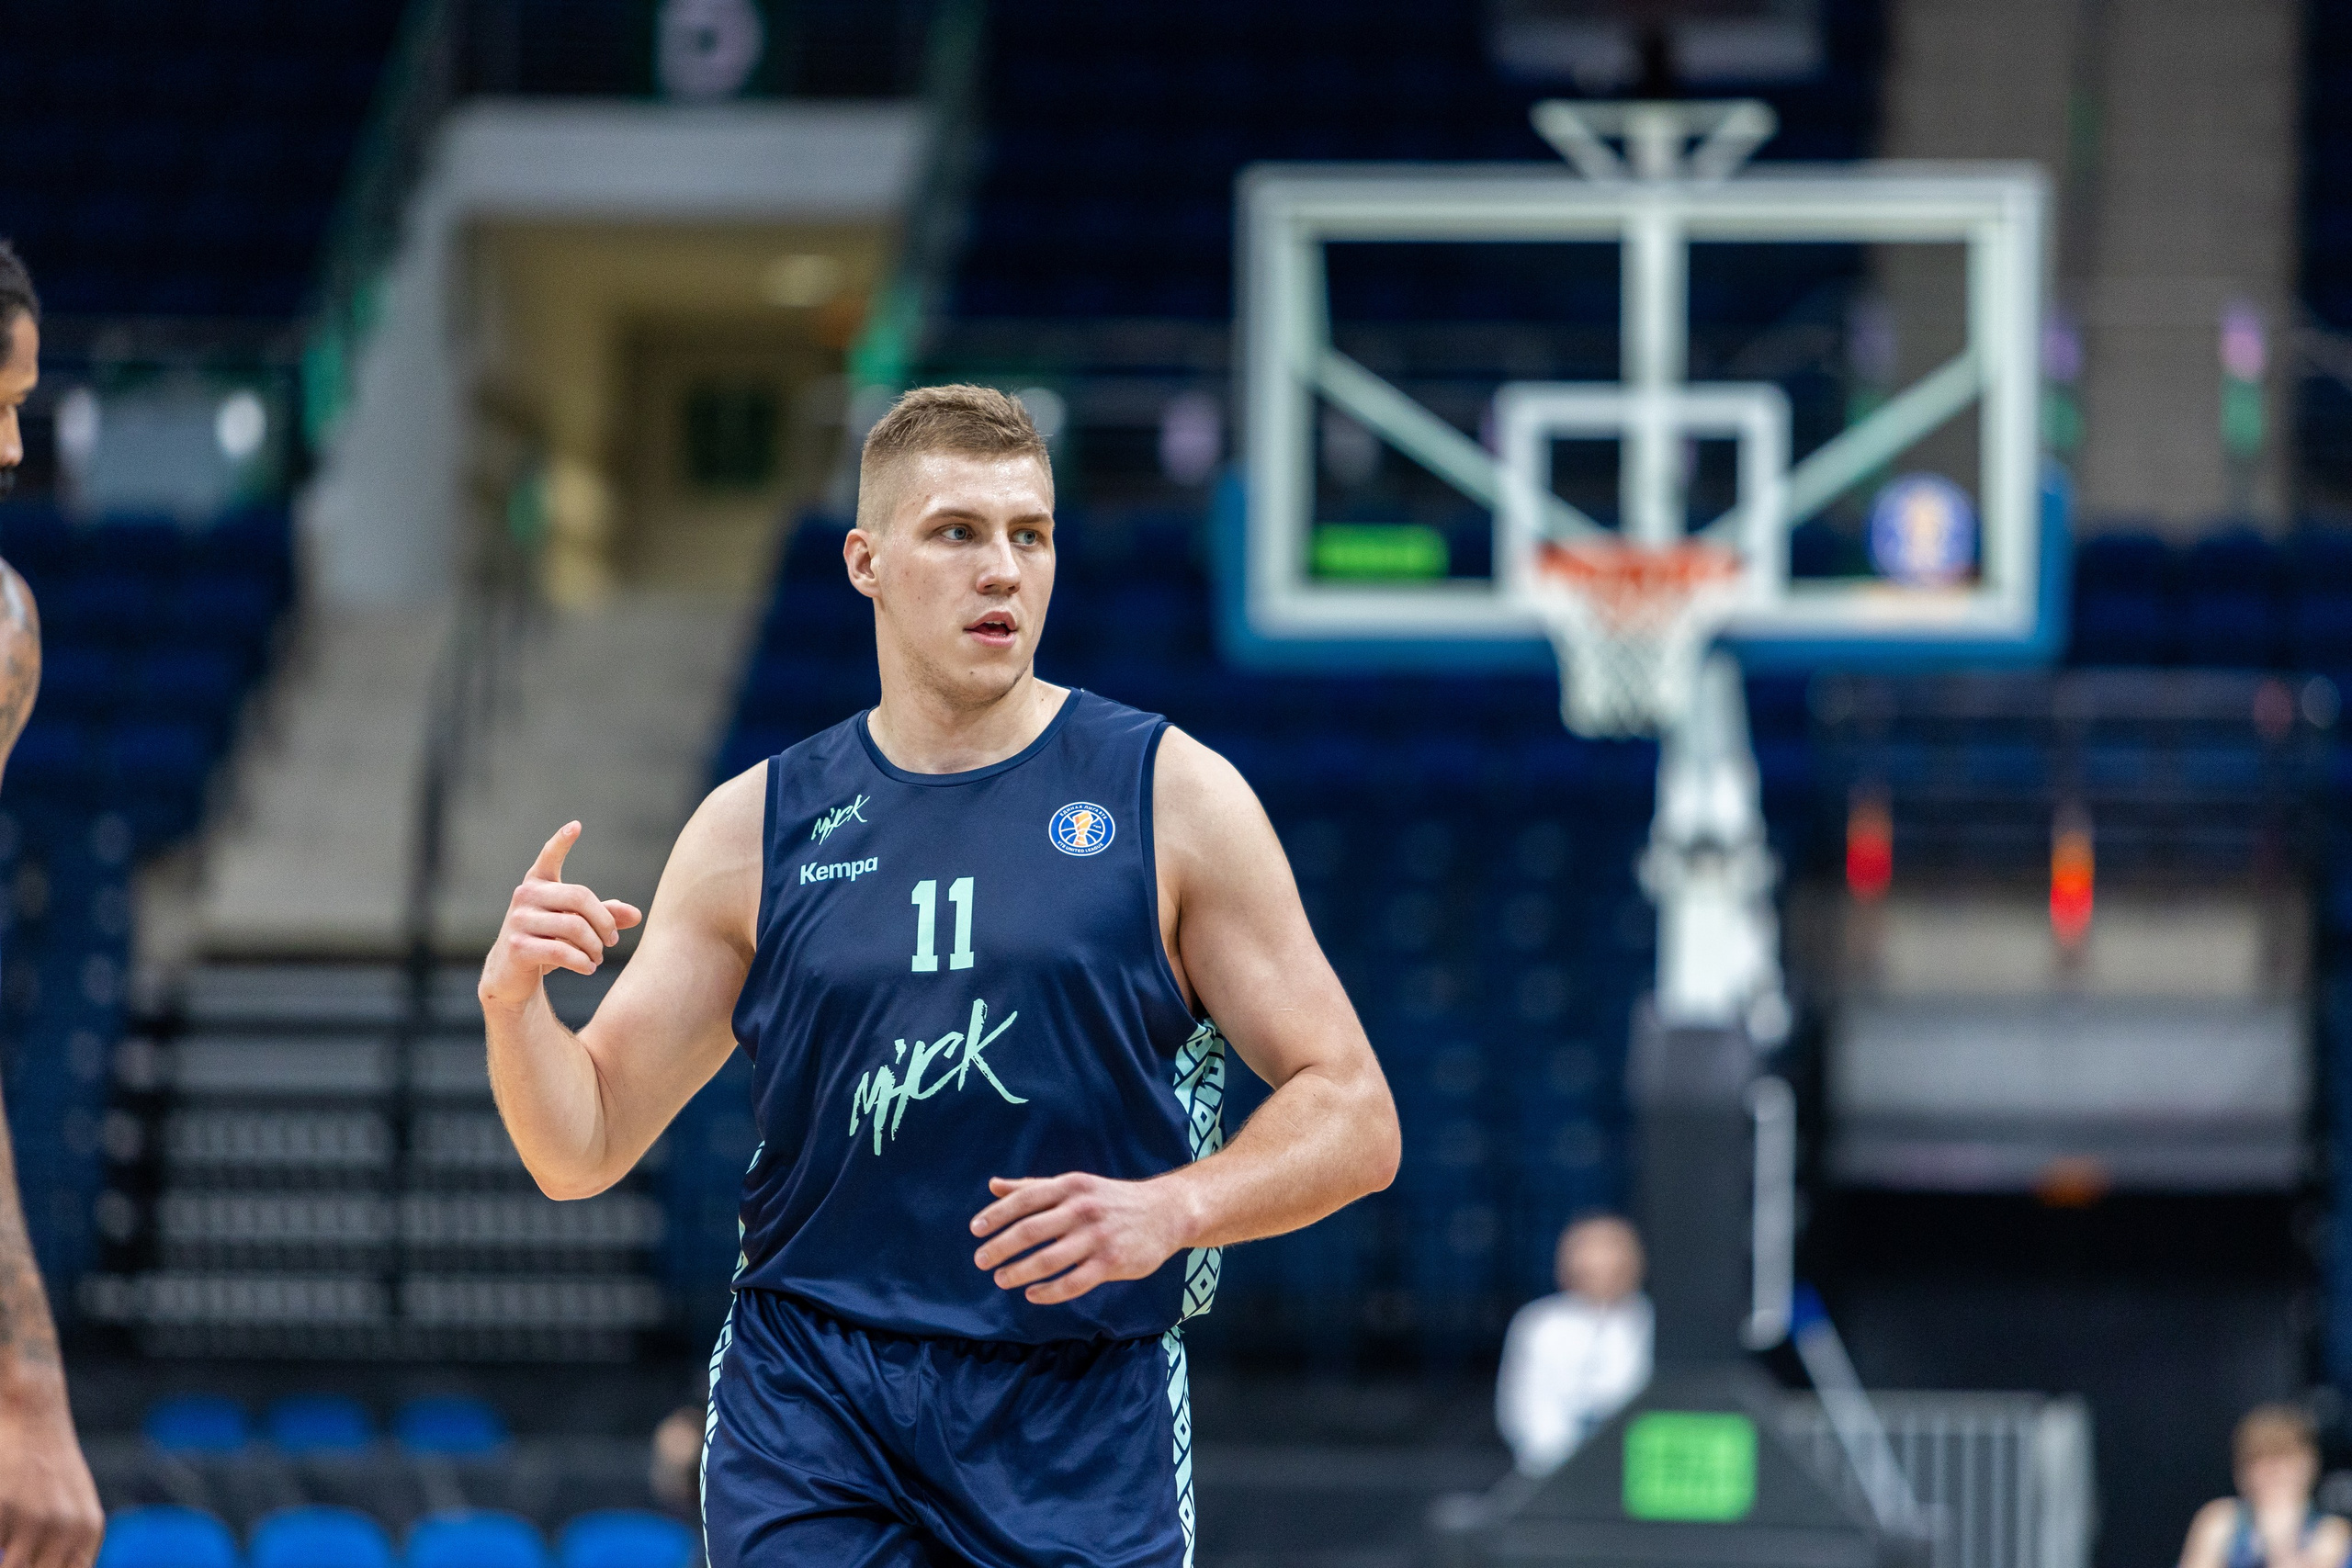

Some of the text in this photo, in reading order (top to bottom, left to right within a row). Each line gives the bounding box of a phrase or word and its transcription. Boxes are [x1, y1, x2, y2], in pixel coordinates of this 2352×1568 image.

[1085, 842, 1104, 852] LEAGUE
[799, 856, 878, 886] Kempa
[910, 876, 975, 973] 11
